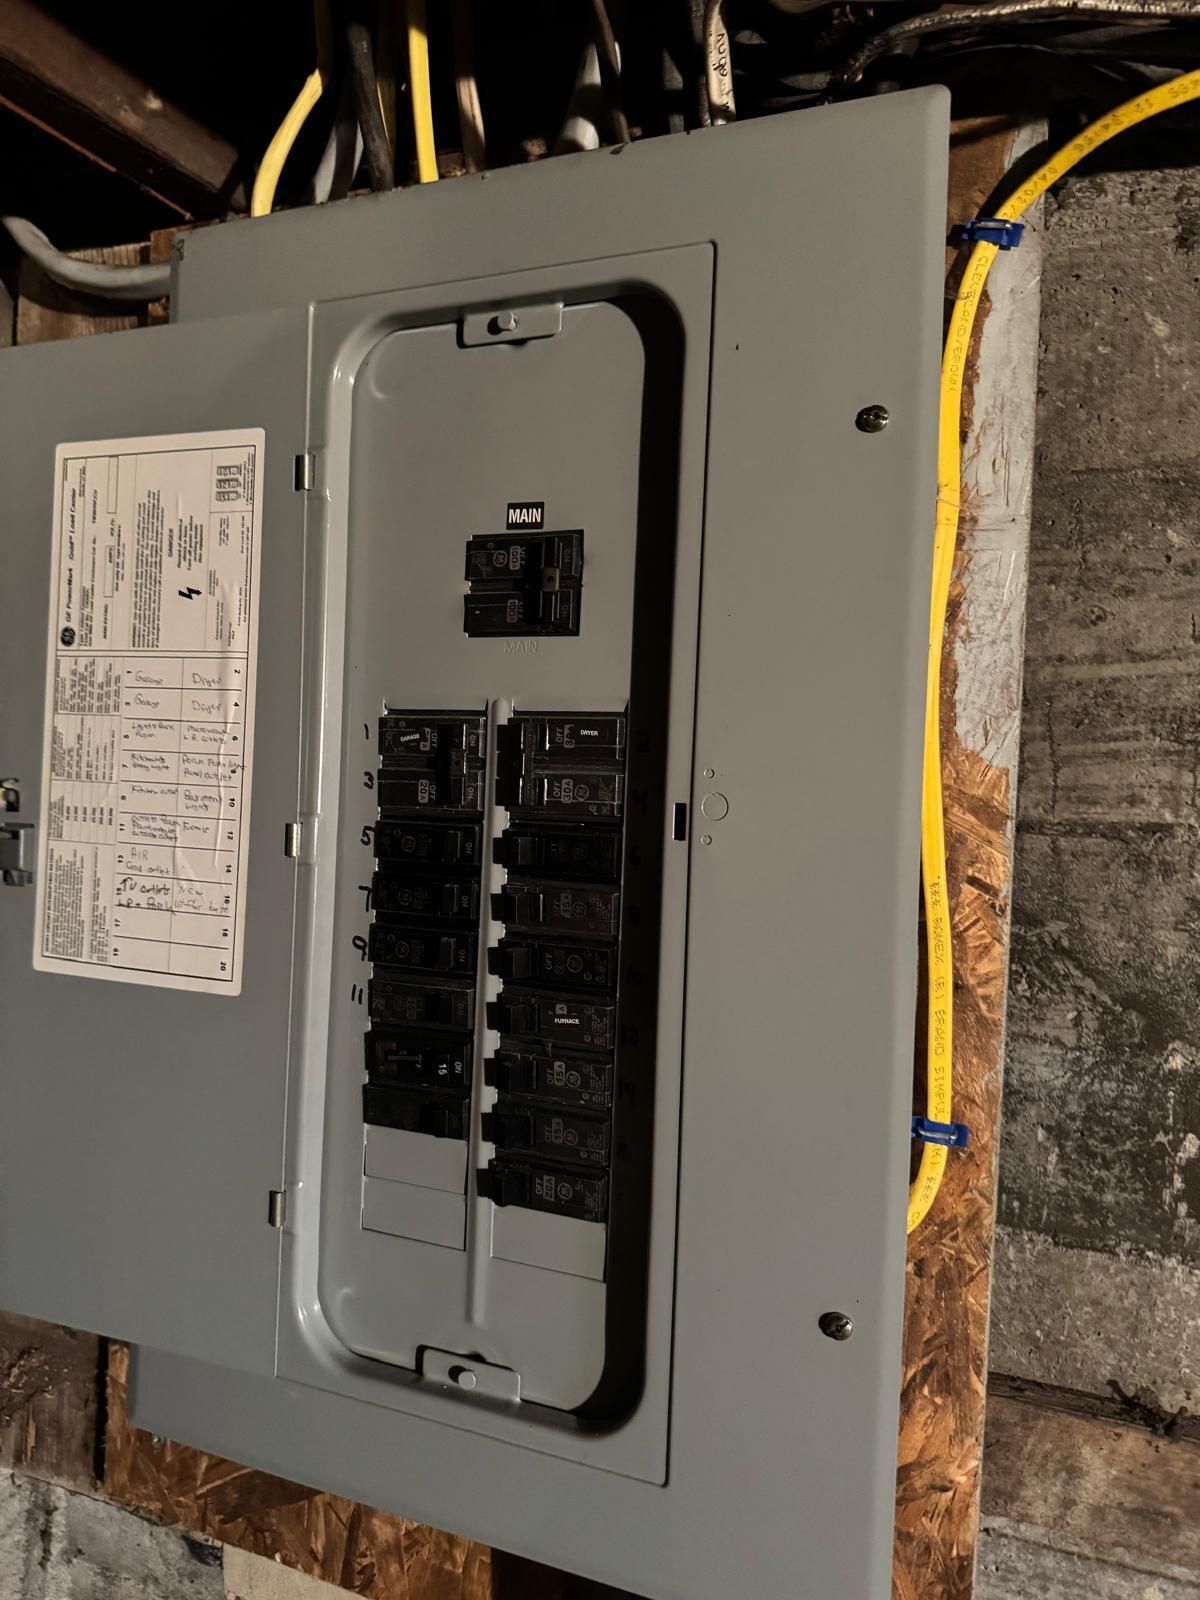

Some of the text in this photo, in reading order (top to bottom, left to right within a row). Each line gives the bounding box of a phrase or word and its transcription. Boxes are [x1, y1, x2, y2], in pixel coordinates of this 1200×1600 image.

[507, 507, 542, 524] MAIN
[505, 639, 539, 654] MAIN
[363, 723, 370, 741] 1
[399, 732, 421, 743] GARAGE
[580, 729, 599, 737] DRYER
[363, 770, 375, 790] 3
[419, 780, 429, 801] 20A
[553, 780, 561, 798] OFF
[562, 779, 572, 802] 30A
[228, 798, 236, 807] 10
[119, 823, 126, 831] 11
[227, 831, 234, 841] 12
[360, 825, 375, 846] 5
[225, 864, 232, 873] 14
[358, 884, 373, 913] 7
[114, 918, 121, 927] 17
[352, 934, 368, 962] 9
[220, 961, 227, 971] 20
[544, 952, 553, 970] OFF
[351, 983, 364, 1006] 11
[554, 1017, 580, 1025] FURNACE
[437, 1063, 448, 1076] 15
[454, 1060, 464, 1075] ON
[545, 1067, 554, 1085] OFF
[554, 1063, 564, 1084] 15A
[535, 1176, 543, 1195] OFF
[544, 1177, 555, 1200] 20A
